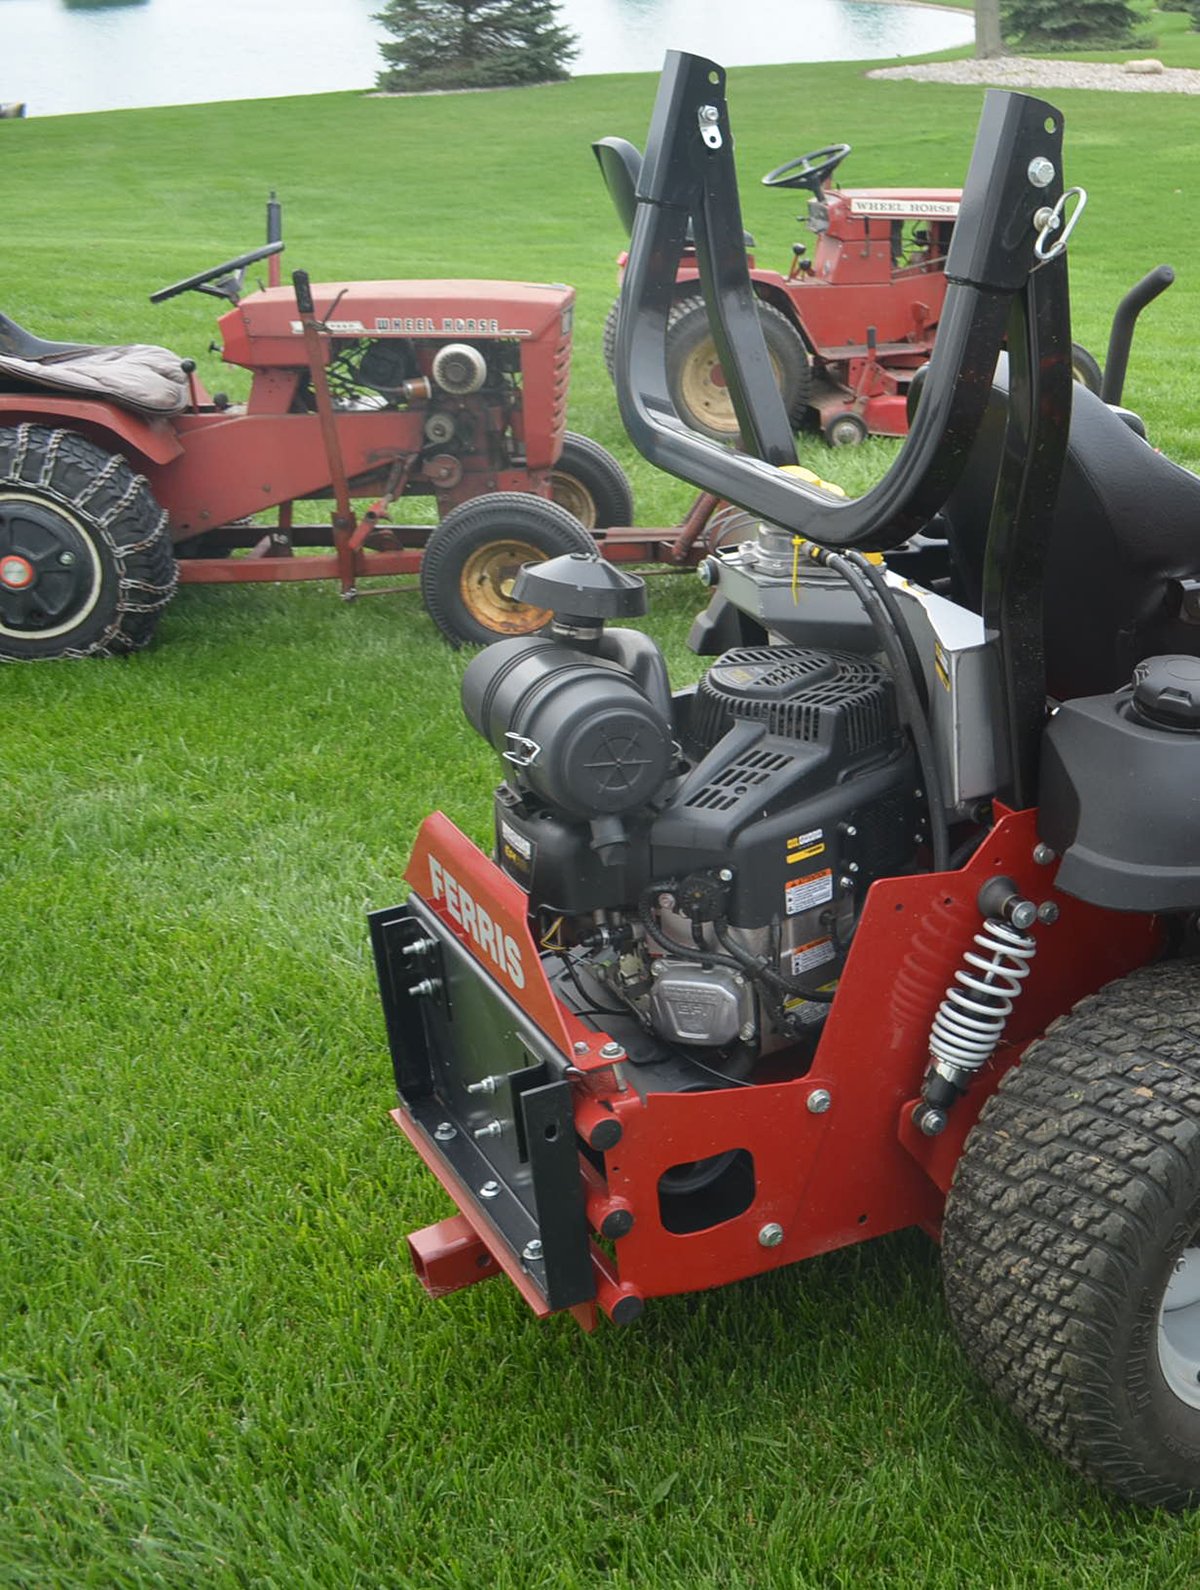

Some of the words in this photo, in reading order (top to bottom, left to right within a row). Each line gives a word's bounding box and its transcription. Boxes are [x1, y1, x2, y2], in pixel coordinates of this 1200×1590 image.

[856, 202, 904, 212] WHEEL
[910, 203, 953, 213] HORSE
[374, 317, 435, 332] WHEEL
[442, 317, 499, 332] HORSE
[428, 853, 525, 989] FERRIS
